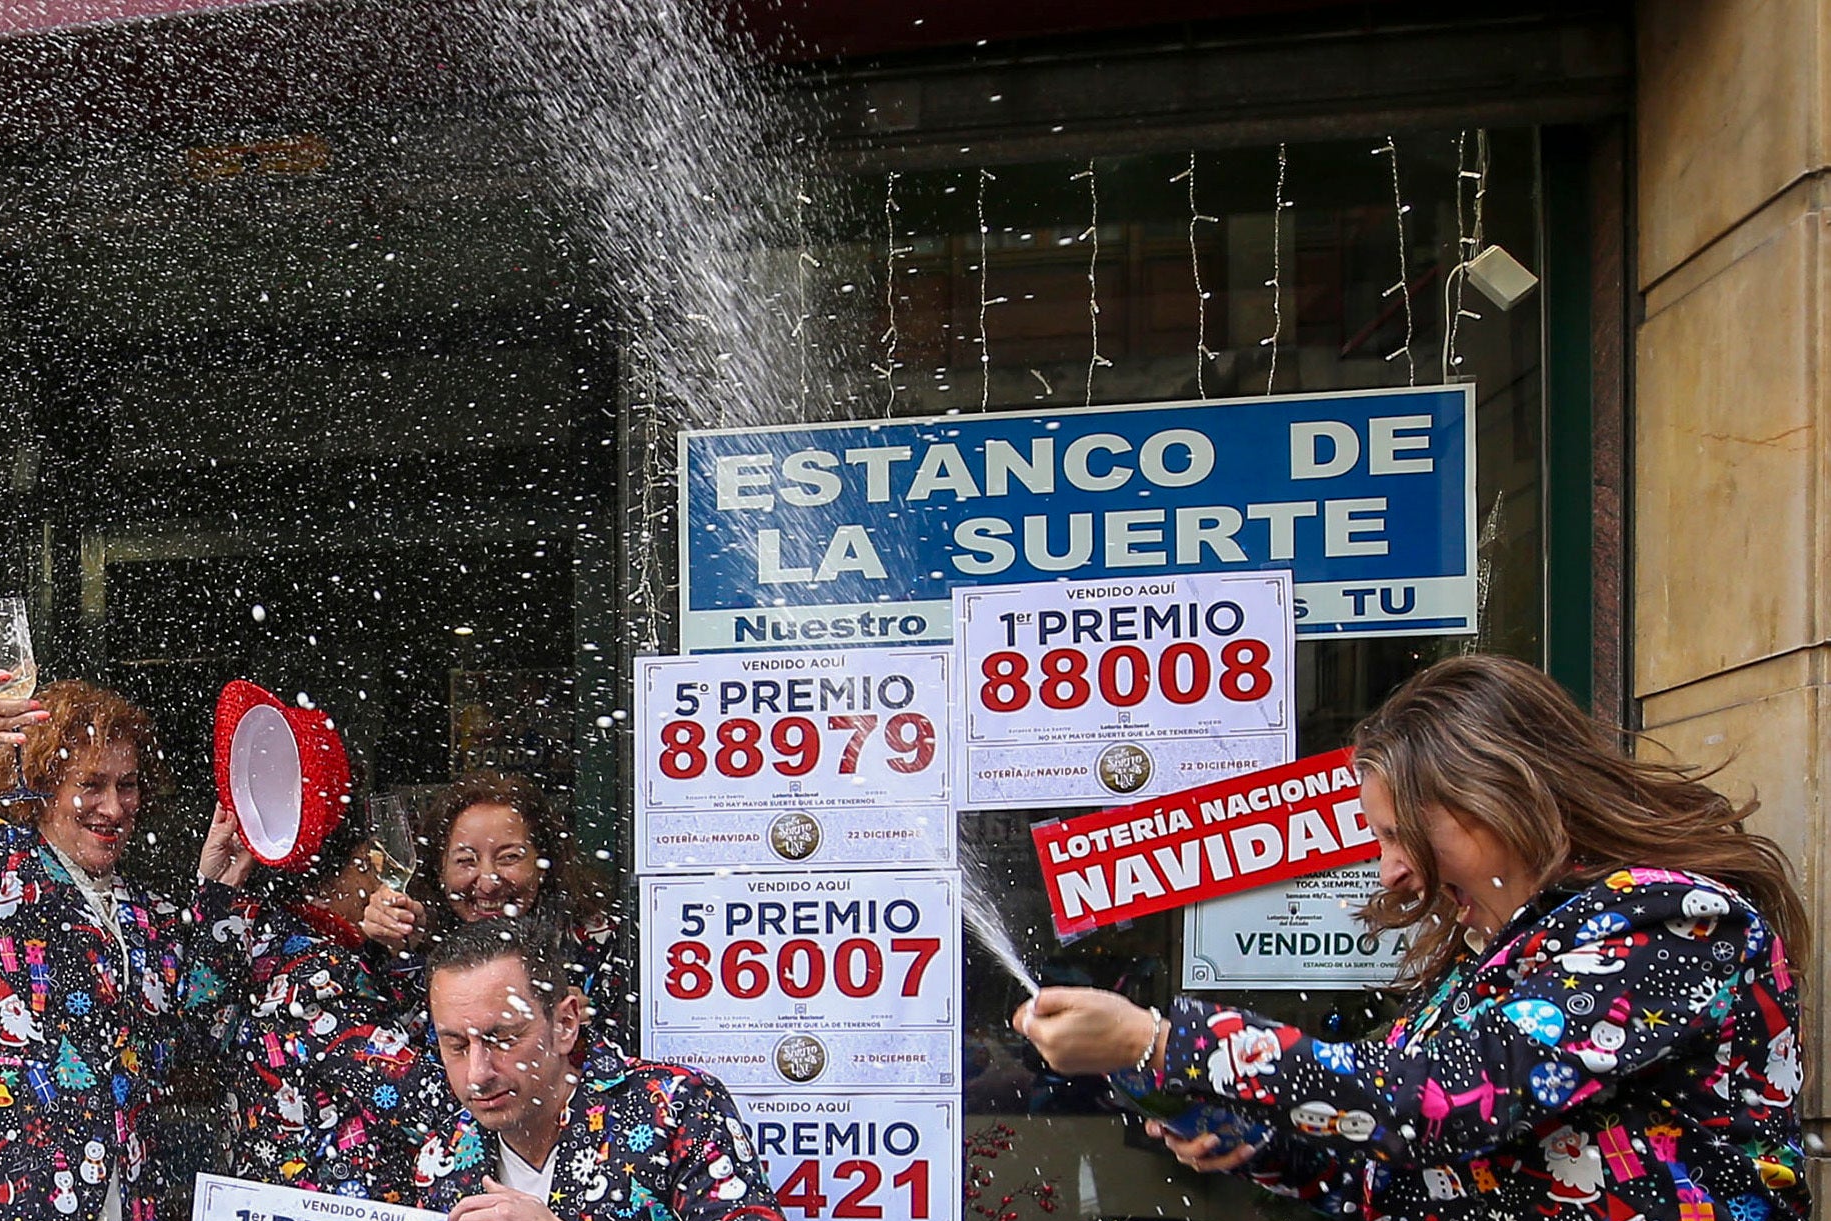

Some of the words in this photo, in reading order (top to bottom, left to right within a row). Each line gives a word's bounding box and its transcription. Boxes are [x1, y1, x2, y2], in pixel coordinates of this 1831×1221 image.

[716, 428, 1215, 511] ESTANCO
[1289, 414, 1434, 480] DE
[758, 524, 887, 584] LA
[951, 497, 1389, 576] SUERTE
[1066, 586, 1133, 600] VENDIDO
[1138, 581, 1176, 596] AQUÍ
[734, 611, 926, 643] Nuestro
[1342, 586, 1416, 617] TU
[1000, 611, 1032, 647] 1er
[1039, 600, 1245, 645] PREMIO
[742, 660, 805, 671] VENDIDO
[810, 655, 846, 669] AQUÍ
[980, 639, 1273, 713] 88008
[720, 674, 915, 715] PREMIO
[659, 712, 936, 779] 88979
[1069, 732, 1095, 740] MAYOR
[1097, 731, 1126, 739] SUERTE
[978, 767, 1023, 779] LOTERÍA
[1036, 766, 1088, 777] NAVIDAD
[1180, 762, 1193, 771] 22
[1196, 759, 1258, 770] DICIEMBRE
[770, 799, 797, 807] SUERTE
[1048, 808, 1193, 864] LOTERÍA
[1199, 765, 1364, 826] NACIONA
[712, 833, 760, 843] NAVIDAD
[848, 831, 859, 839] 22
[863, 829, 922, 840] DICIEMBRE
[1055, 798, 1377, 919] NAVIDAD
[748, 881, 811, 893] VENDIDO
[815, 878, 850, 892] AQUÍ
[1322, 881, 1363, 889] SIEMPRE,
[1342, 871, 1360, 879] DOS
[726, 899, 920, 936] PREMIO
[1235, 932, 1379, 956] VENDIDO
[664, 938, 940, 999] 86007
[718, 1055, 766, 1064] NAVIDAD
[853, 1055, 865, 1063] 22
[869, 1054, 926, 1063] DICIEMBRE
[748, 1102, 812, 1113] VENDIDO
[816, 1099, 850, 1113] AQUÍ
[761, 1160, 929, 1220] 421
[302, 1199, 366, 1219] VENDIDO
